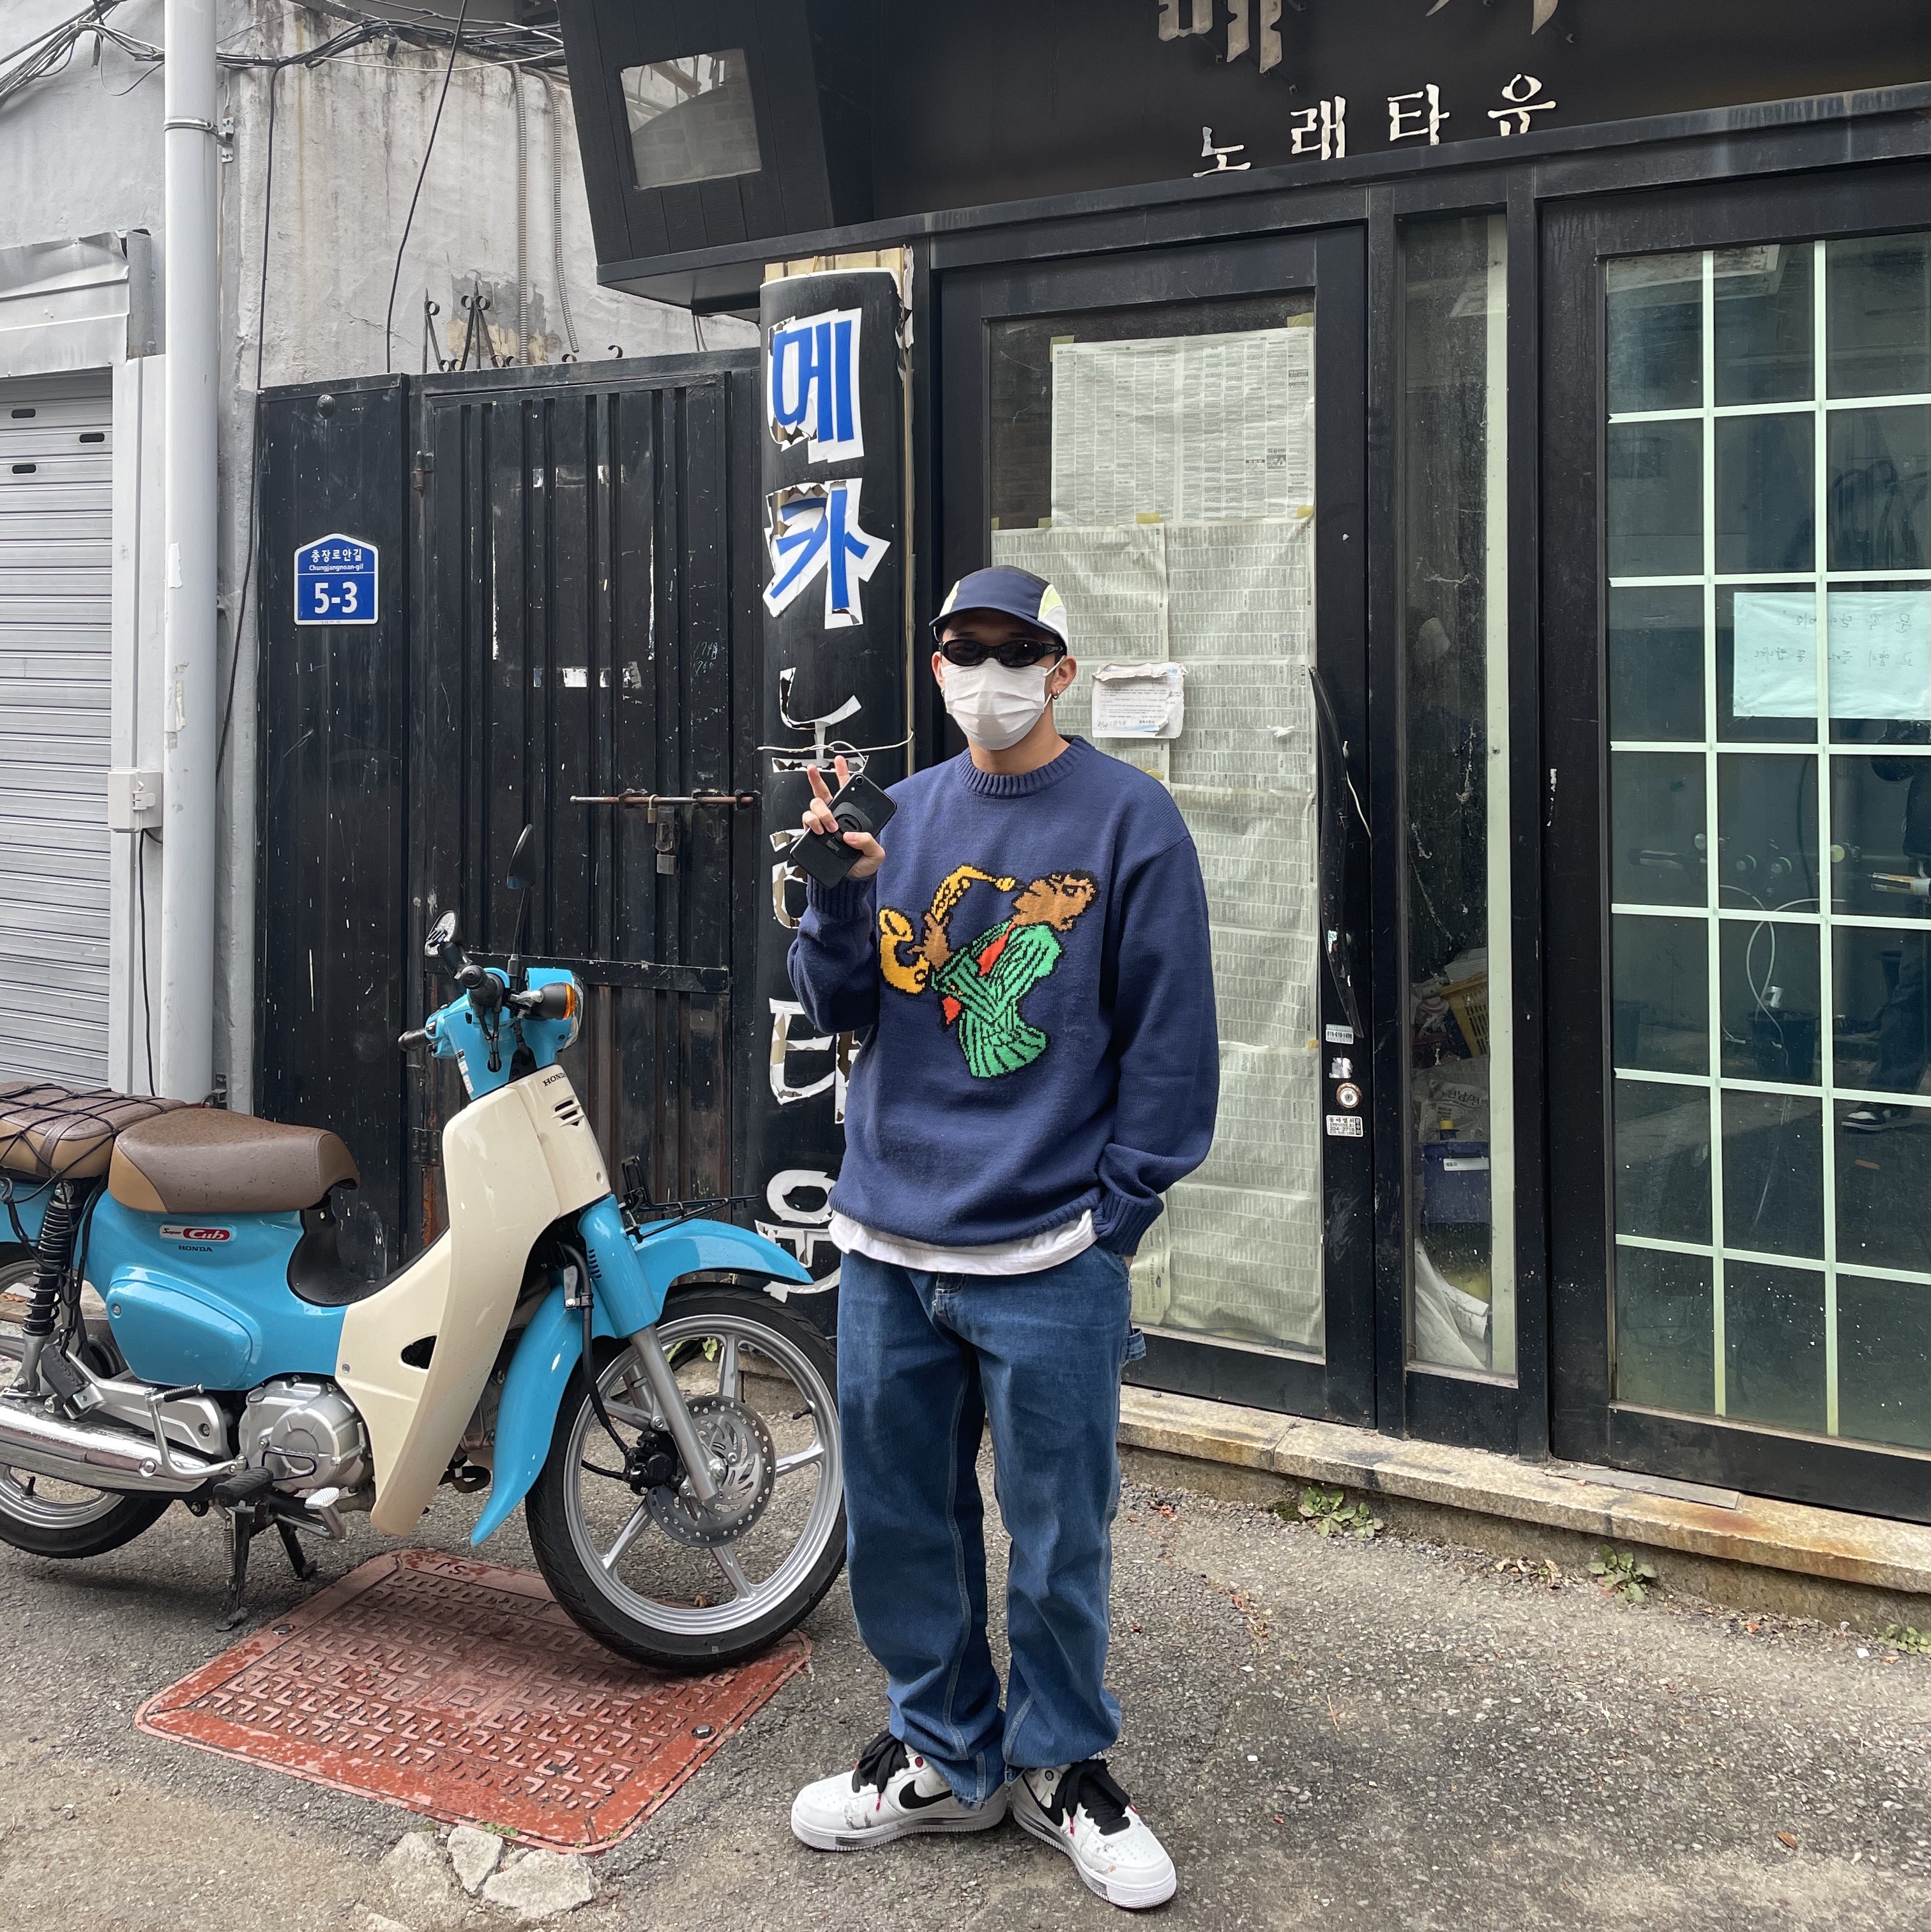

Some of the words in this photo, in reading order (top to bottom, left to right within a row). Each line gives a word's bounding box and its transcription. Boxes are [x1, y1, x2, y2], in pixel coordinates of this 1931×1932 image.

[764, 308, 890, 629] 메카
[310, 548, 362, 563] 충장로안길
[314, 581, 358, 614] 5-3
[188, 1229, 224, 1240] Cub
